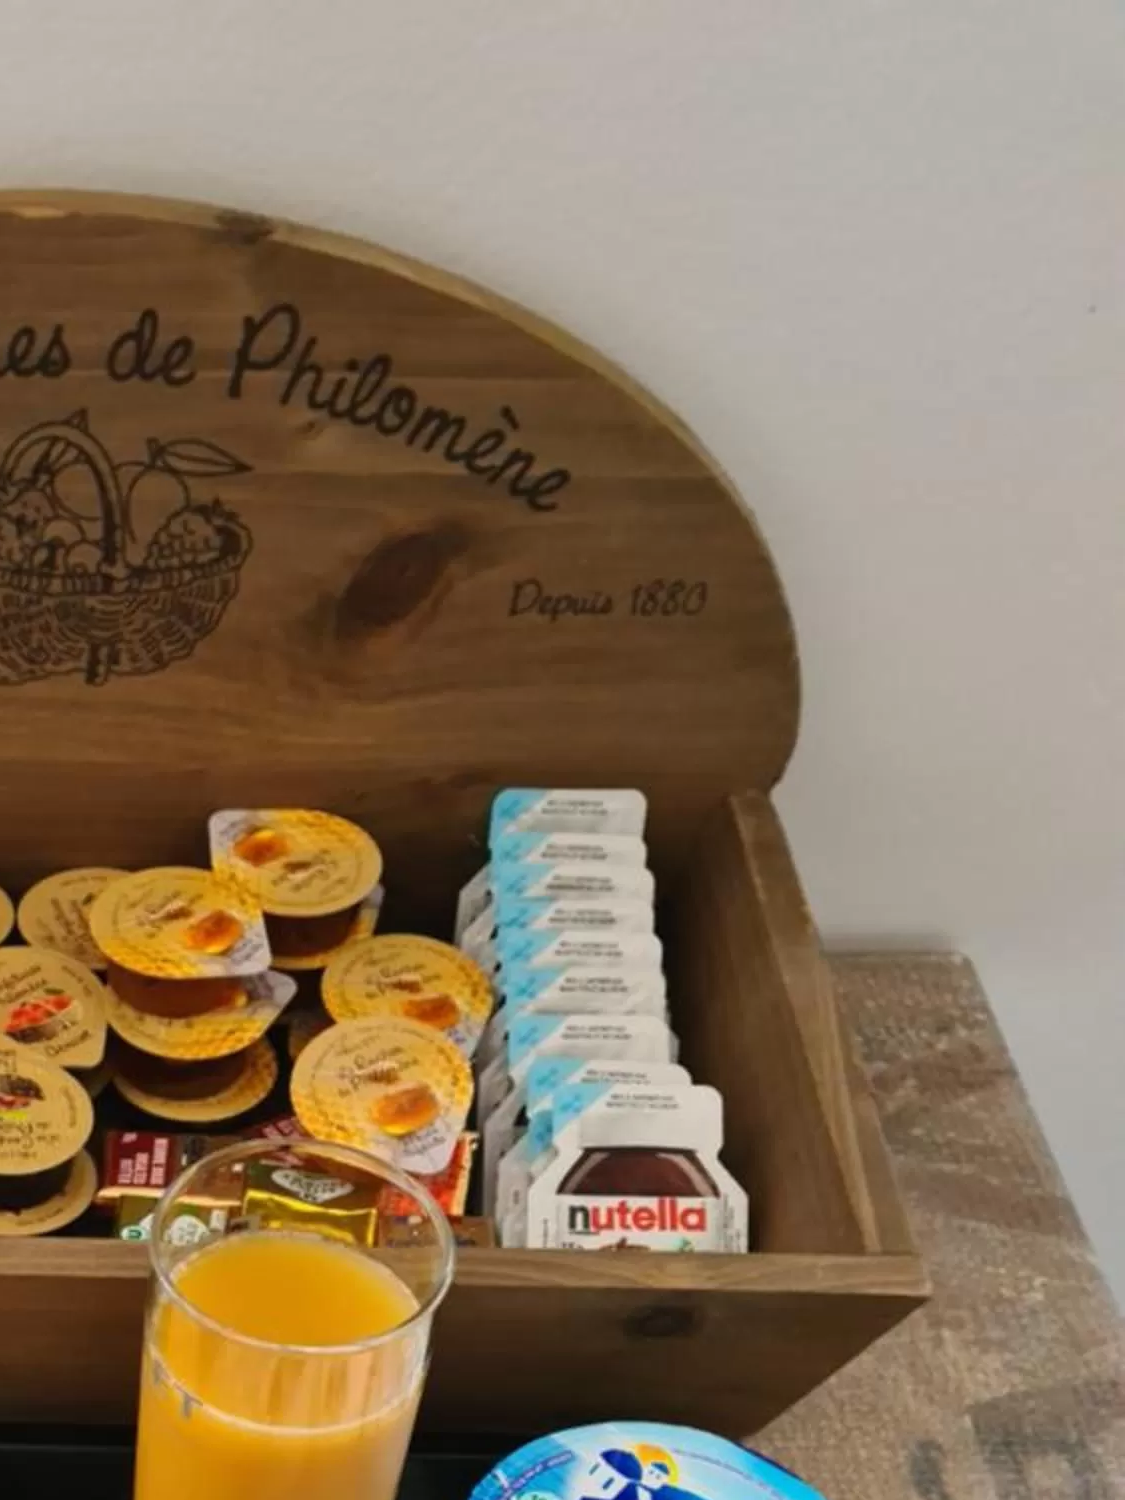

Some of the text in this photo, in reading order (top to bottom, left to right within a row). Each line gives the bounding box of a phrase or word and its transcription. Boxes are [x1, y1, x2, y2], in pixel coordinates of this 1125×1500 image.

[106, 307, 197, 385] de
[228, 302, 572, 512] Philomène
[508, 579, 708, 624] Depuis 1880
[568, 1196, 707, 1233] nutella
